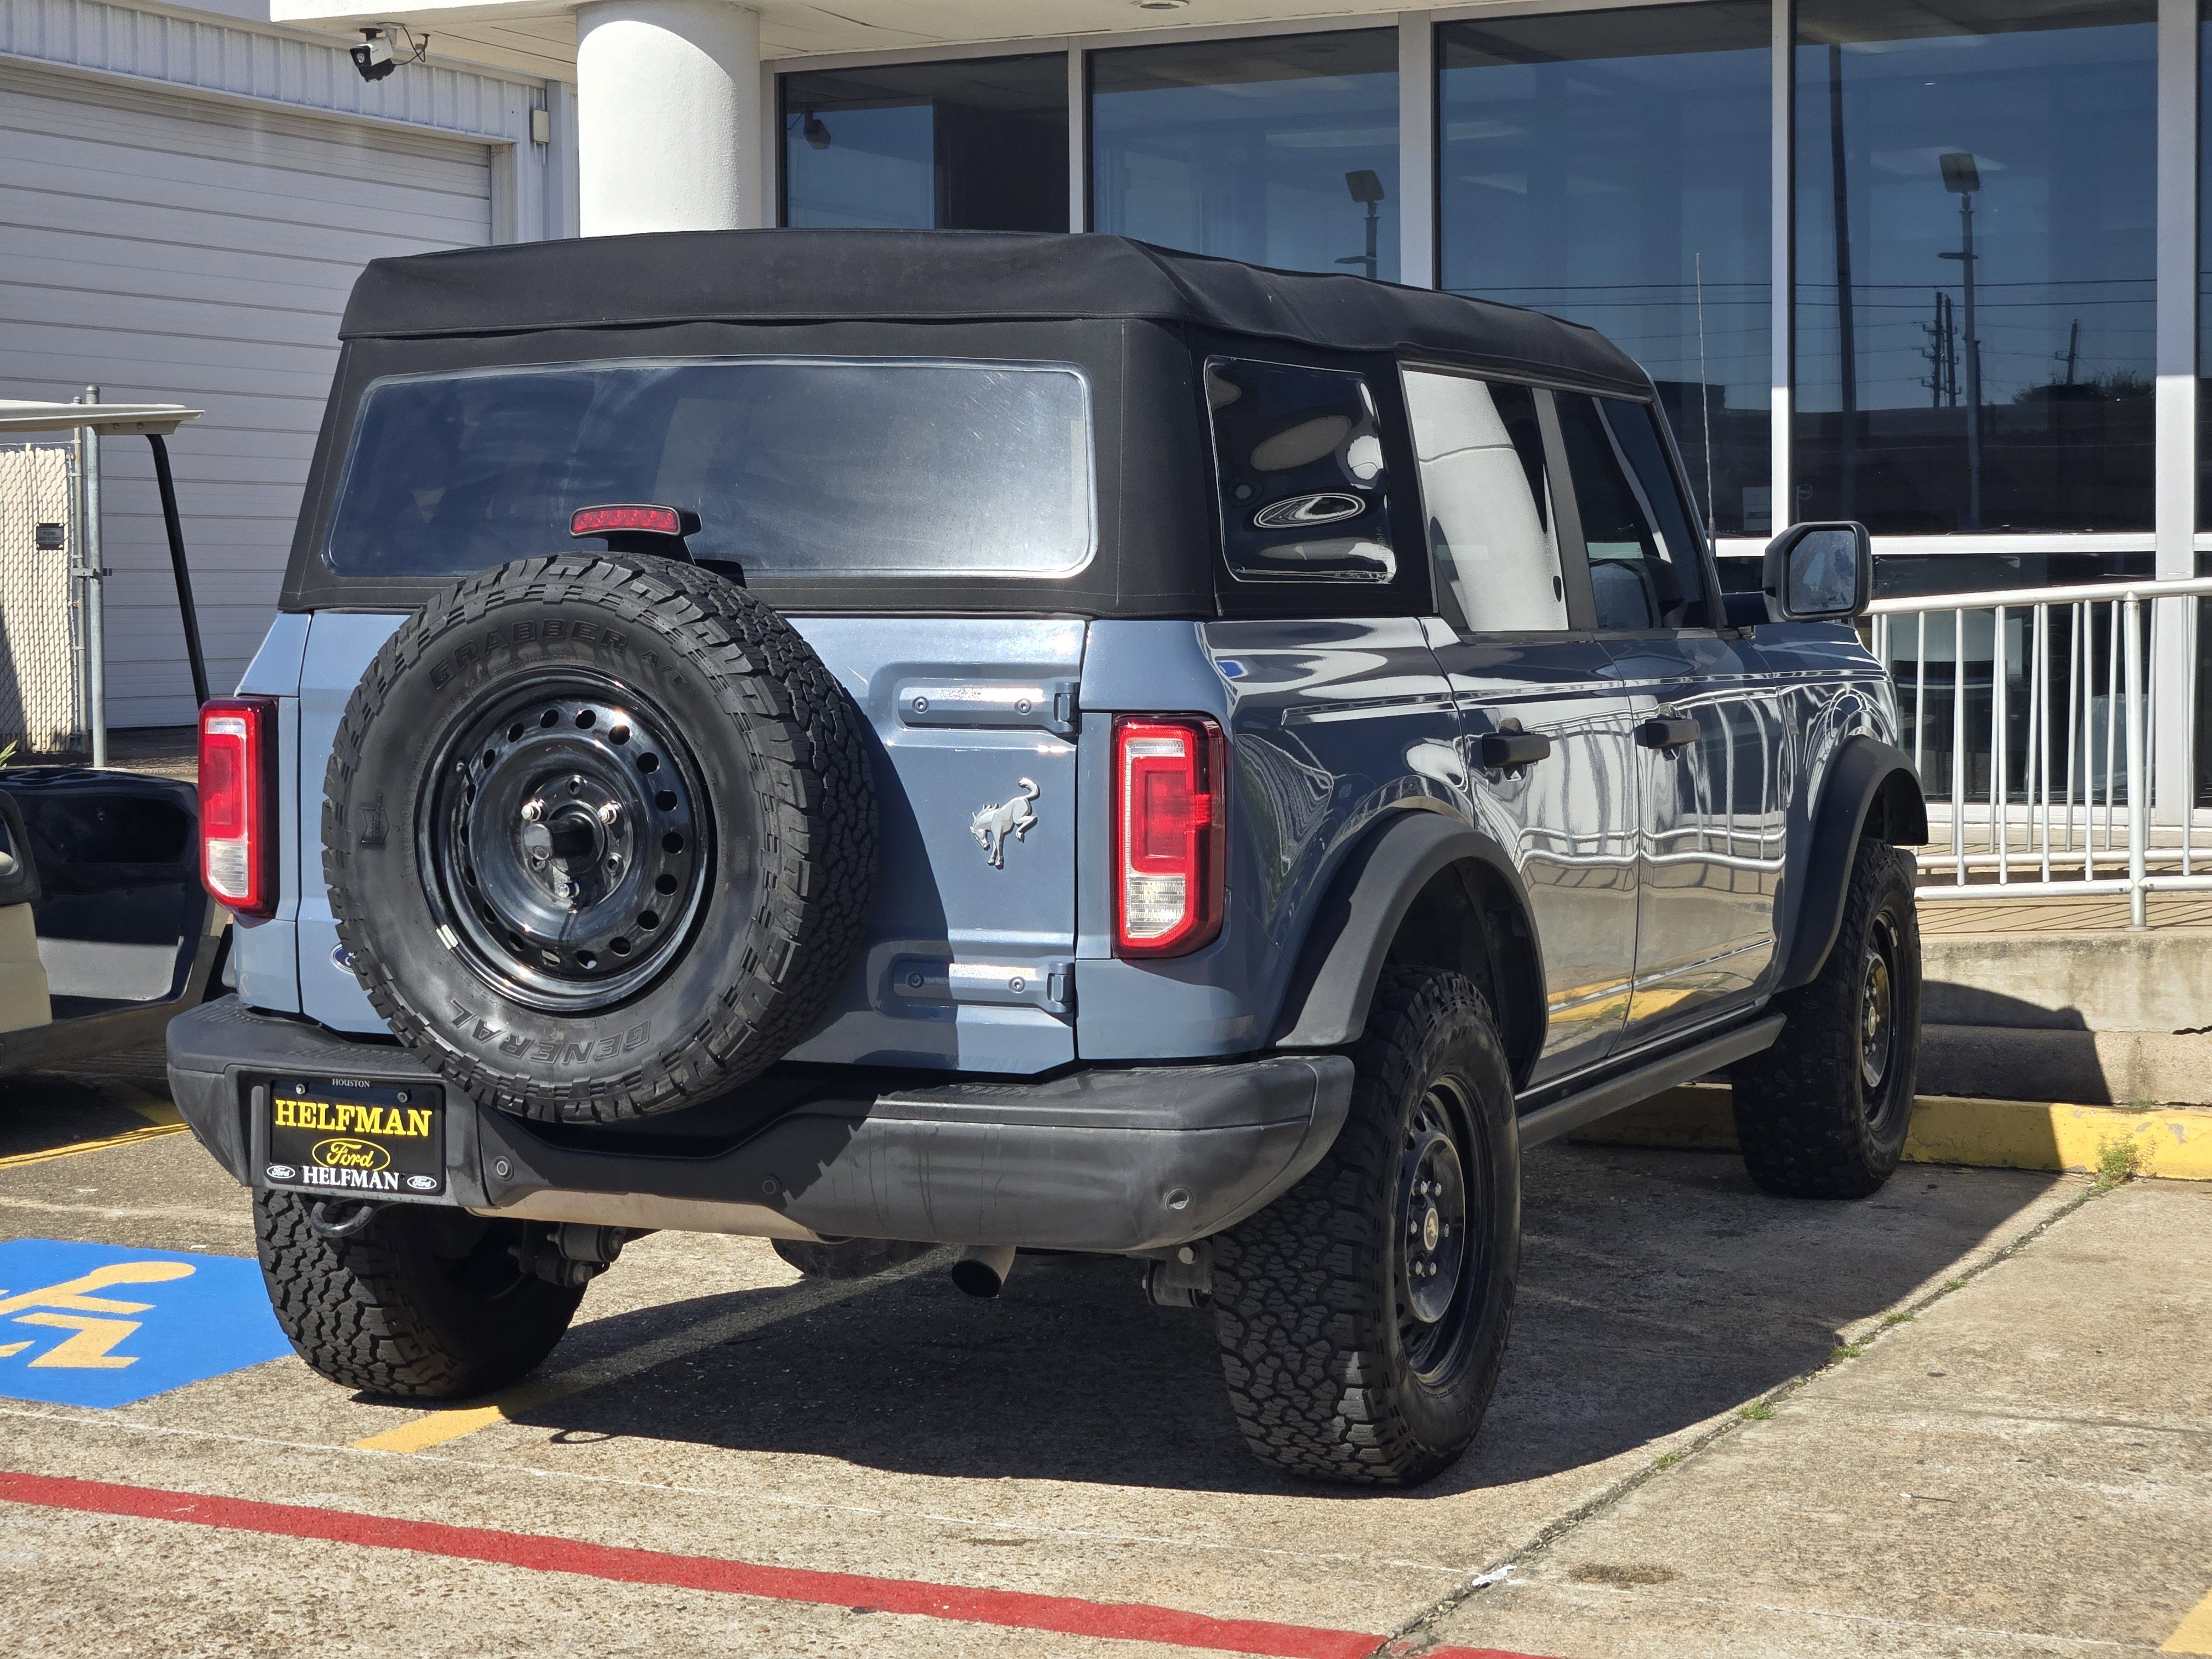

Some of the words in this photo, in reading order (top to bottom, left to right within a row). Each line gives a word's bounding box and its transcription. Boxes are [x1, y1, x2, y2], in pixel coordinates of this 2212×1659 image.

[429, 618, 629, 690] GRABBER
[450, 999, 651, 1066] GENERAL
[332, 1078, 371, 1088] HOUSTON
[275, 1099, 432, 1136] HELFMAN
[326, 1141, 374, 1167] Ford
[302, 1165, 400, 1190] HELFMAN
